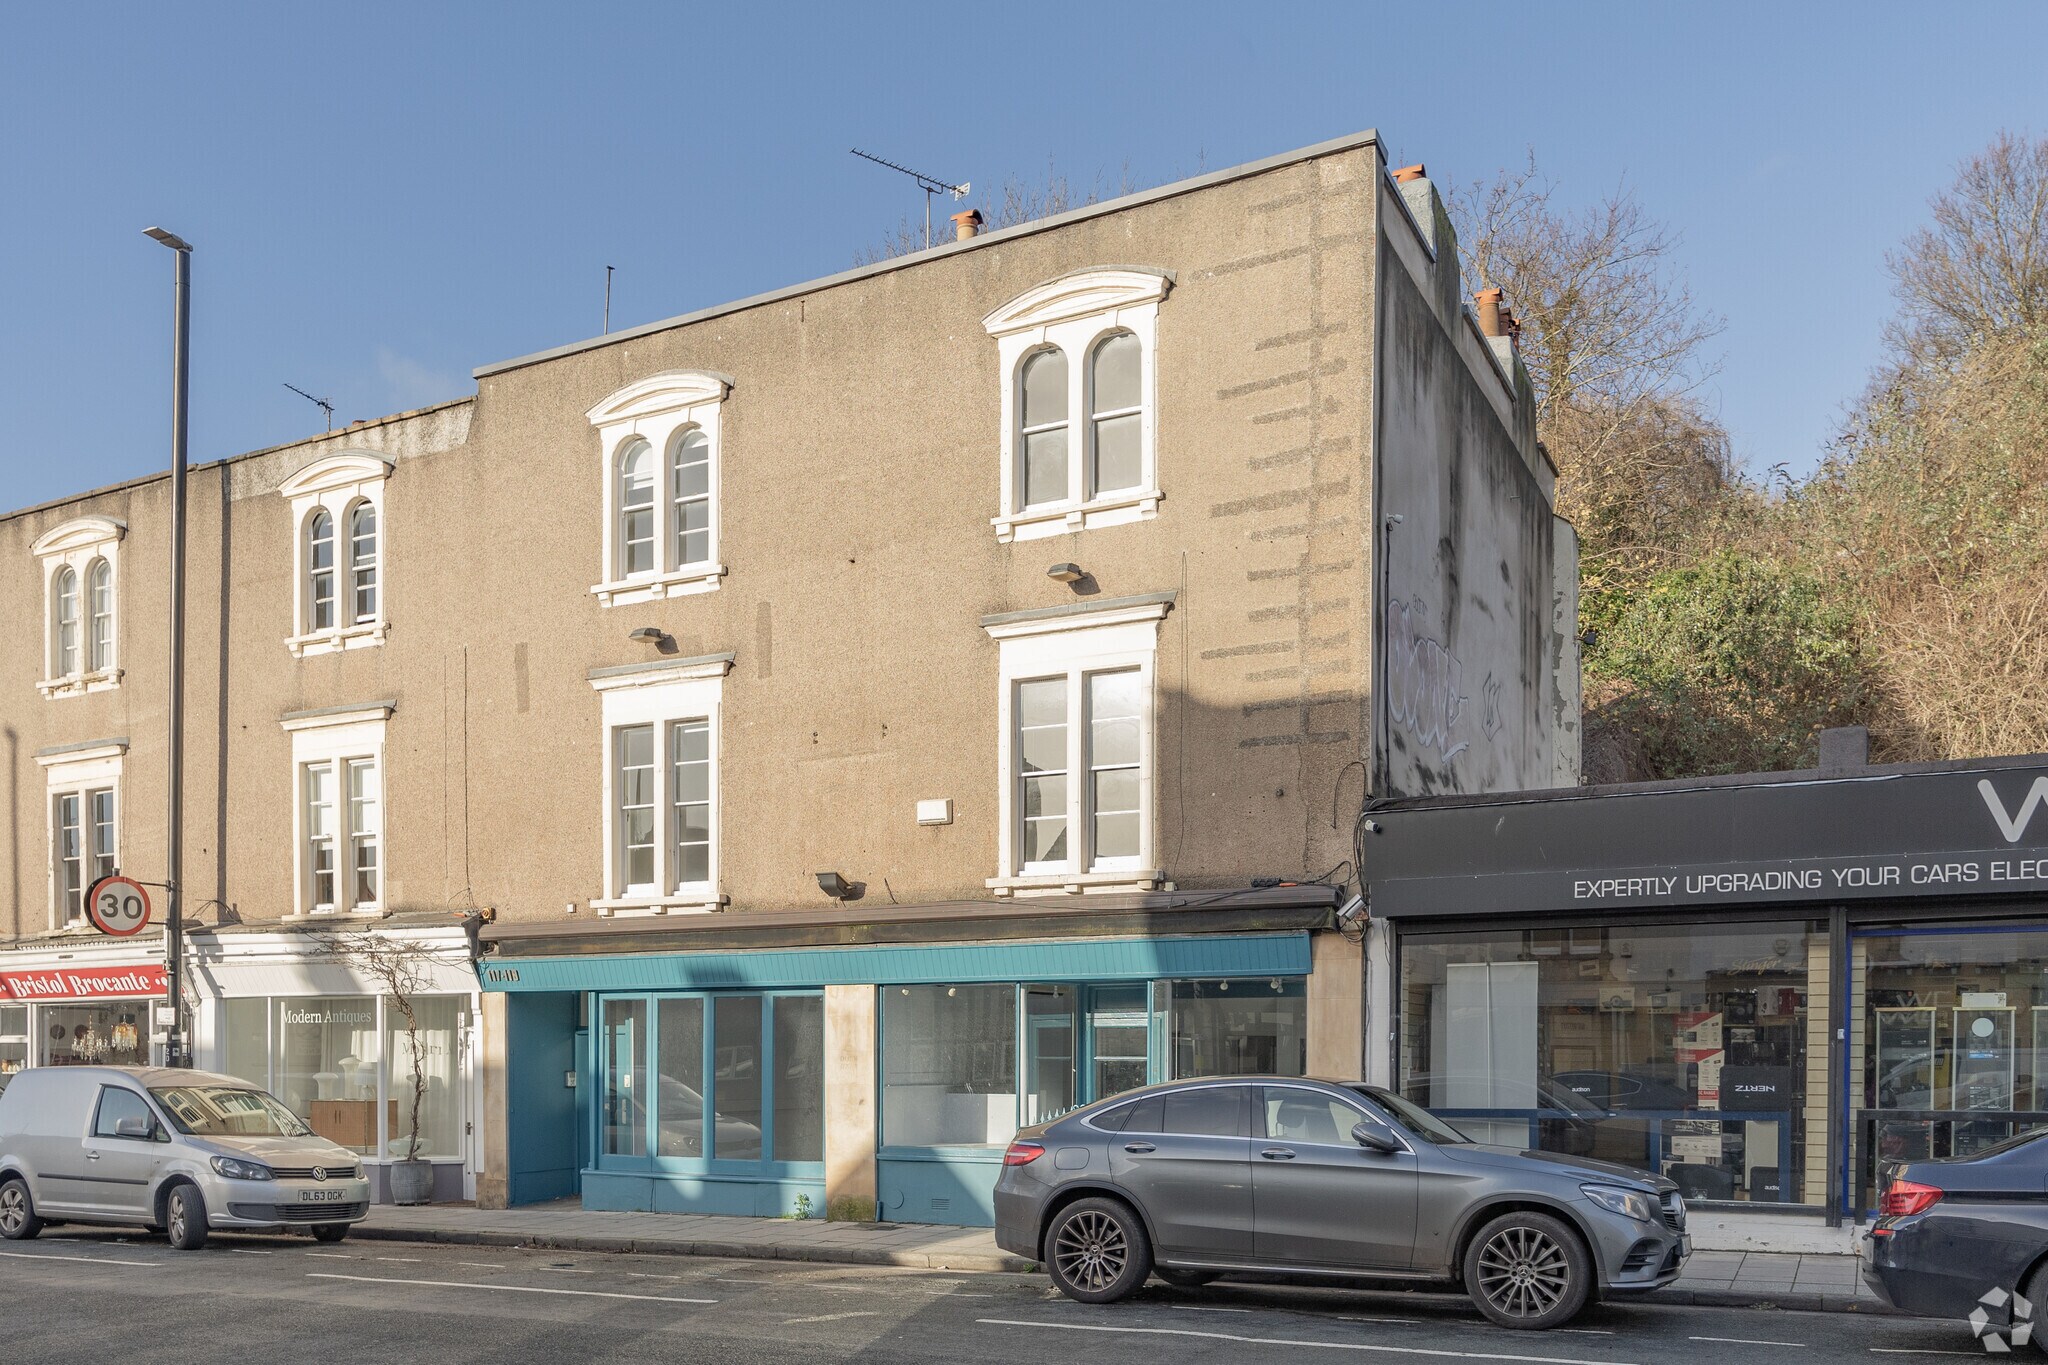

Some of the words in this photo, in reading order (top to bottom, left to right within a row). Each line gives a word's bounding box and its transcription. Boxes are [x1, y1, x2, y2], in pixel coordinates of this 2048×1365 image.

[1574, 876, 1677, 899] EXPERTLY
[1685, 869, 1822, 894] UPGRADING
[1831, 865, 1900, 888] YOUR
[1910, 862, 1979, 884] CARS
[100, 893, 143, 920] 30
[8, 972, 69, 998] Bristol
[68, 972, 151, 996] Brocante
[282, 1008, 323, 1024] Modern
[323, 1008, 372, 1026] Antiques
[302, 1191, 326, 1201] DL63
[327, 1191, 344, 1200] OGK
